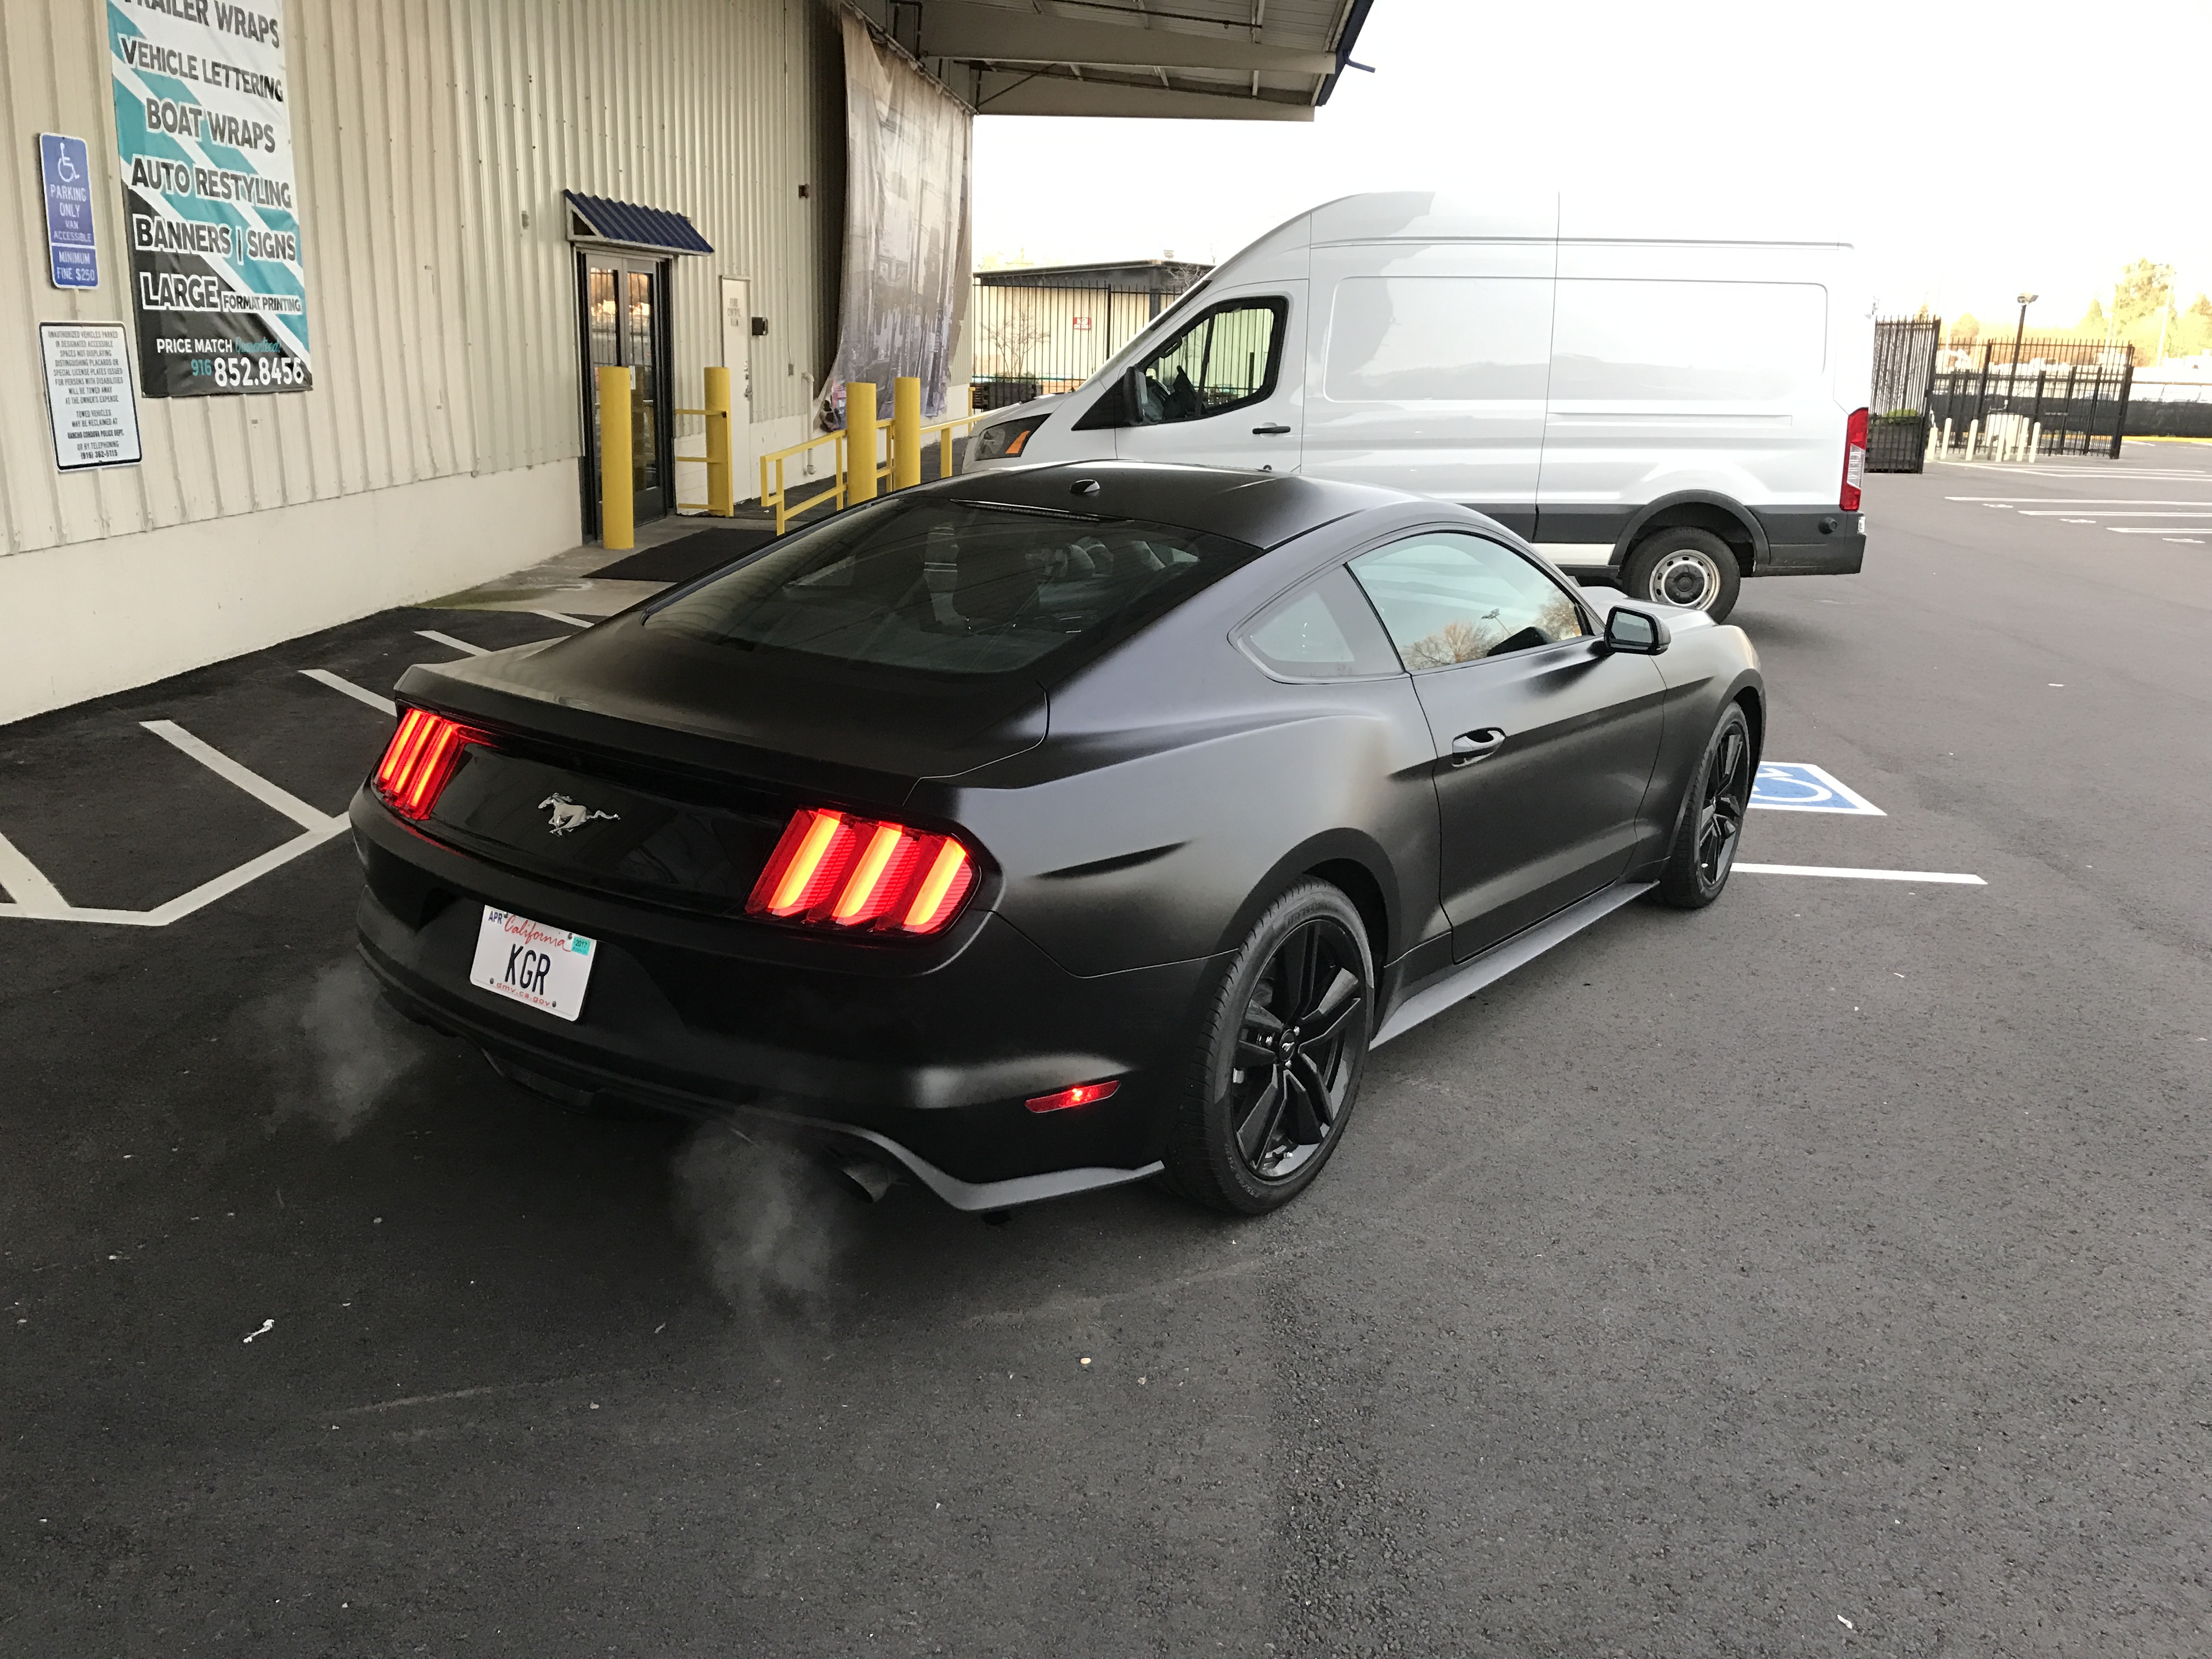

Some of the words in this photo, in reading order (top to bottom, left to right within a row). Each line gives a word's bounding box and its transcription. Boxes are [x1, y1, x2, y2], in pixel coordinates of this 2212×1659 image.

[125, 0, 210, 26] ILER
[215, 0, 279, 48] WRAPS
[121, 37, 199, 80] VEHICLE
[202, 59, 284, 102] LETTERING
[146, 98, 202, 138] BOAT
[207, 111, 275, 153] WRAPS
[50, 184, 87, 201] PARKING
[132, 157, 190, 193] AUTO
[195, 167, 292, 208] RESTYLING
[59, 202, 80, 217] ONLY
[65, 220, 78, 229] VAN
[54, 231, 91, 242] ACCESSIBLE
[136, 219, 232, 255] BANNERS
[247, 230, 296, 261] SIGNS
[59, 251, 90, 264] MINIMUM
[57, 267, 73, 280] FINE
[76, 268, 95, 281] $250
[141, 274, 219, 309] LARGE
[223, 294, 261, 309] FORMAT
[262, 297, 301, 312] PRINTING
[156, 338, 192, 353] PRICE
[194, 338, 232, 353] MATCH
[191, 358, 212, 376] 916
[214, 357, 304, 386] 852.8456
[91, 441, 119, 449] TELEPHONING
[488, 911, 503, 924] APR
[504, 915, 571, 952] California
[575, 939, 588, 949] 2017
[505, 943, 551, 995] KGR
[496, 982, 550, 1006] dmv.ca.gov
